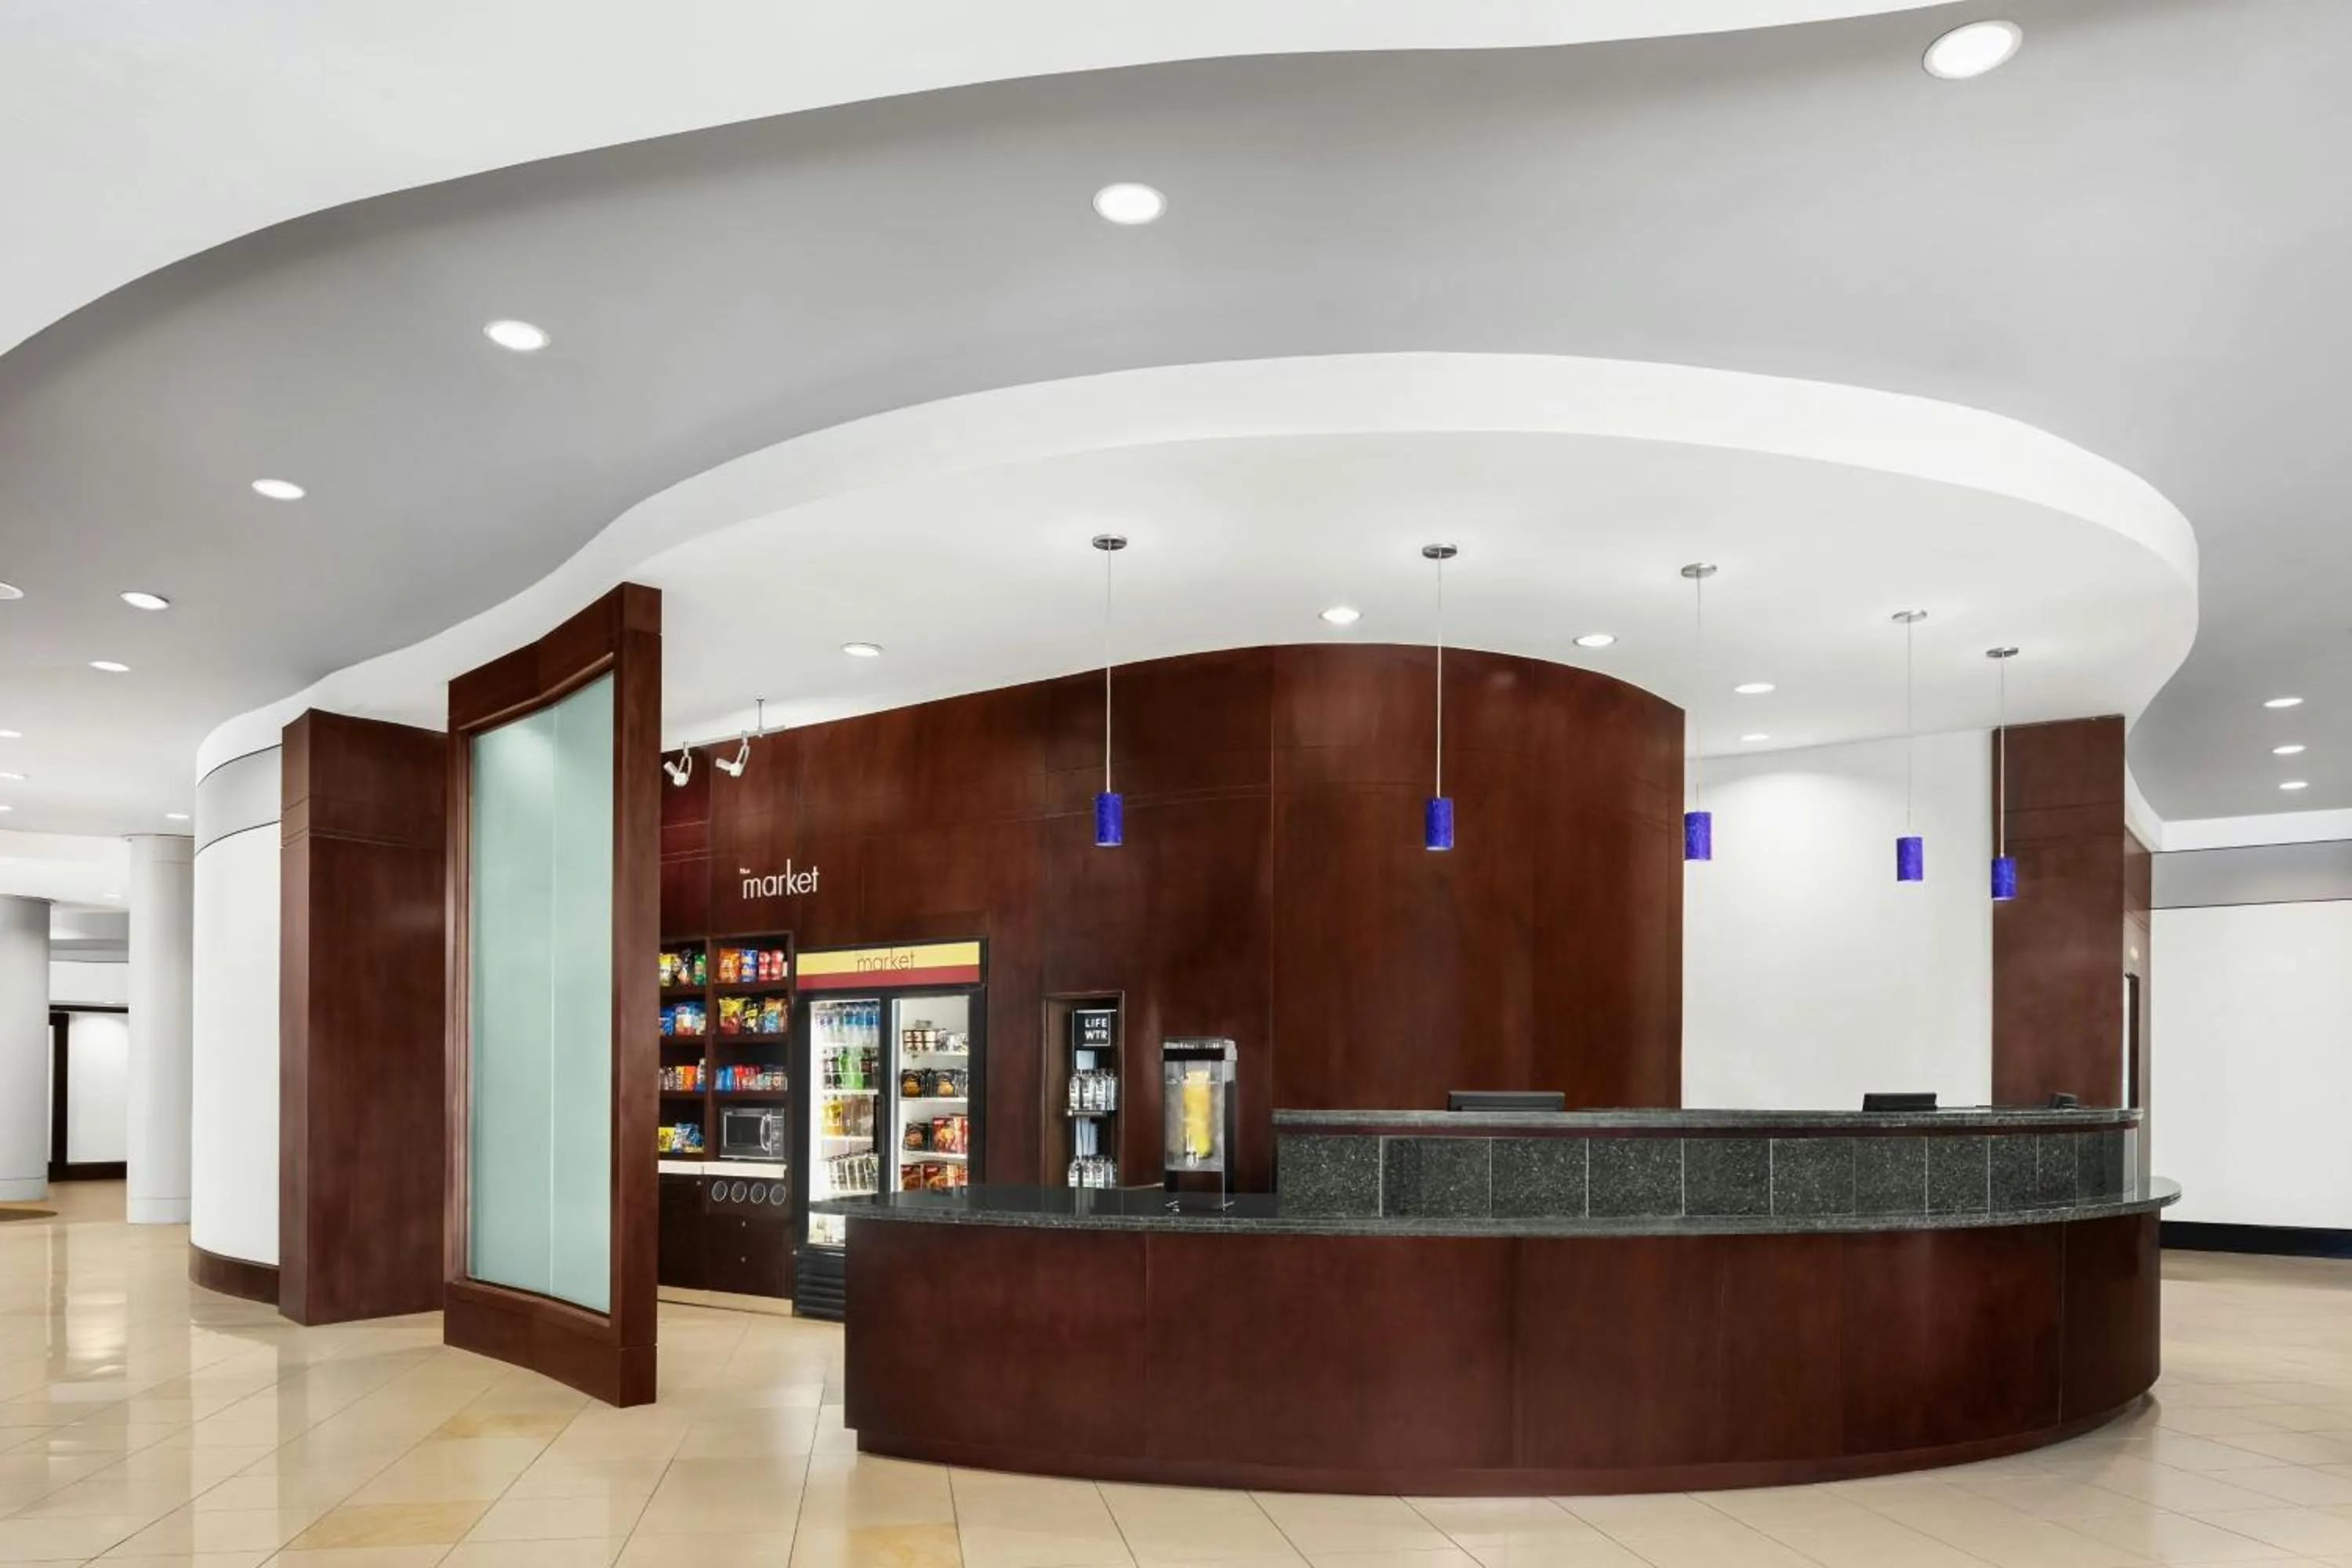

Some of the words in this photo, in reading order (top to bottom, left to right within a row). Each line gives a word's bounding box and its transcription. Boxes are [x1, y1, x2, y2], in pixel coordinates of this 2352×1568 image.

[742, 858, 819, 899] market
[857, 946, 916, 974] market
[1084, 1018, 1107, 1028] LIFE
[1084, 1029, 1108, 1040] WTR
